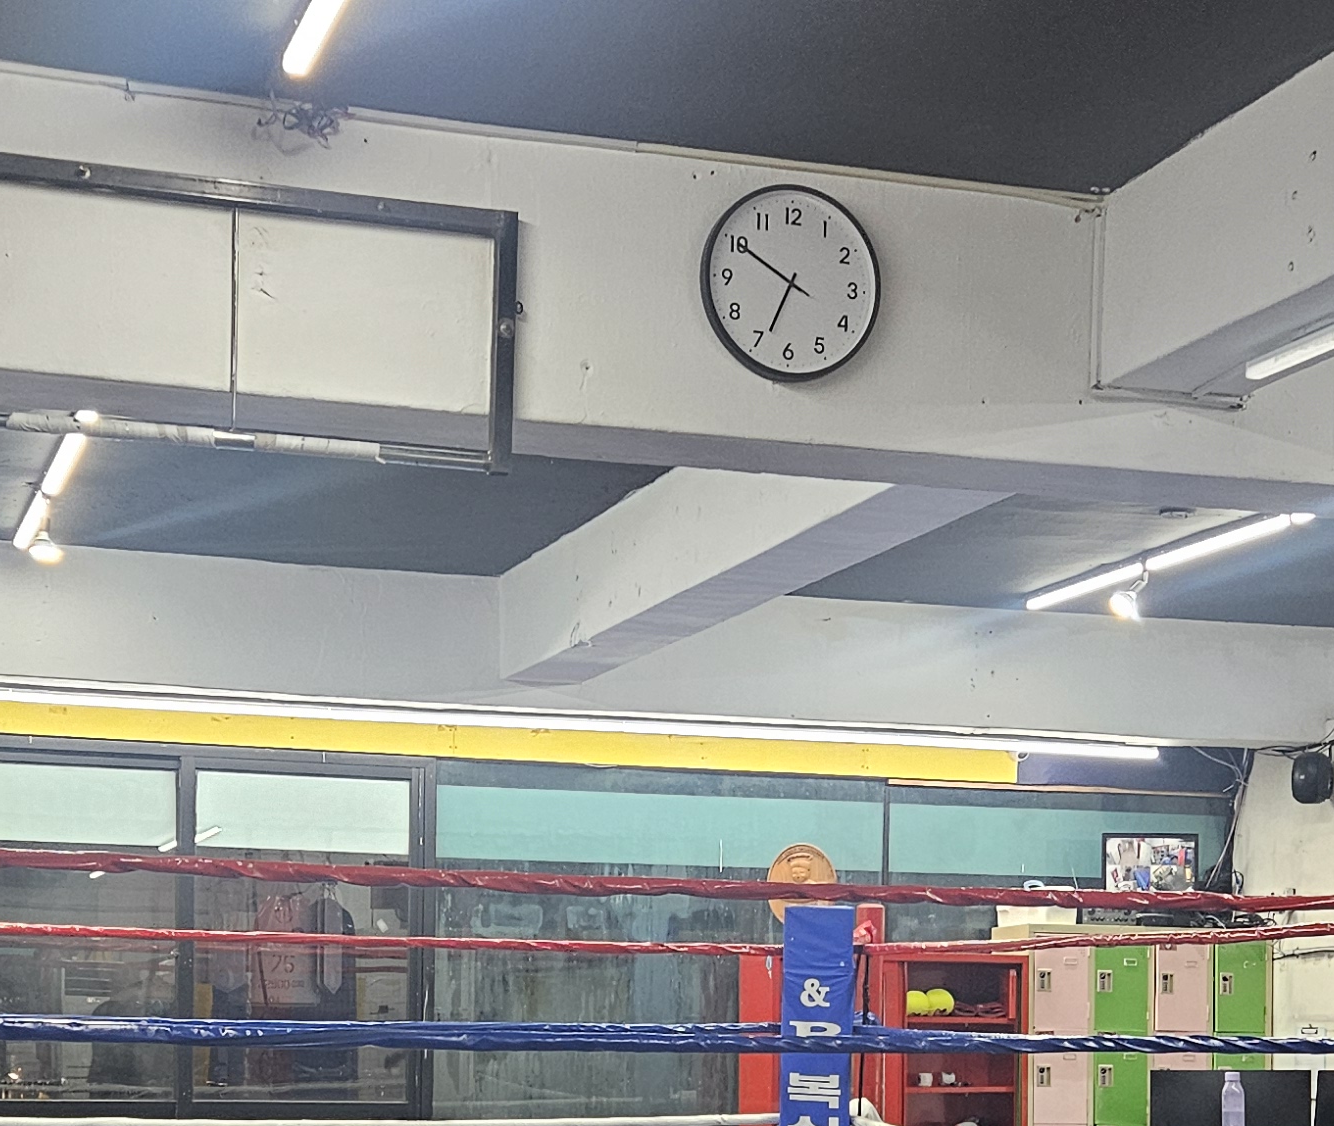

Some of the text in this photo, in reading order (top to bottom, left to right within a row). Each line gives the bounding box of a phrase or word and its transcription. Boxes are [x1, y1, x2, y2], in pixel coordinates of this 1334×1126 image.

[757, 212, 769, 231] 11
[785, 207, 802, 226] 12
[822, 220, 828, 238] 1
[730, 235, 748, 254] 10
[839, 247, 851, 265] 2
[721, 268, 733, 286] 9
[847, 282, 858, 300] 3
[729, 302, 741, 320] 8
[837, 315, 849, 332] 4
[753, 330, 764, 348] 7
[813, 336, 825, 354] 5
[782, 343, 794, 360] 6
[800, 978, 830, 1007] &
